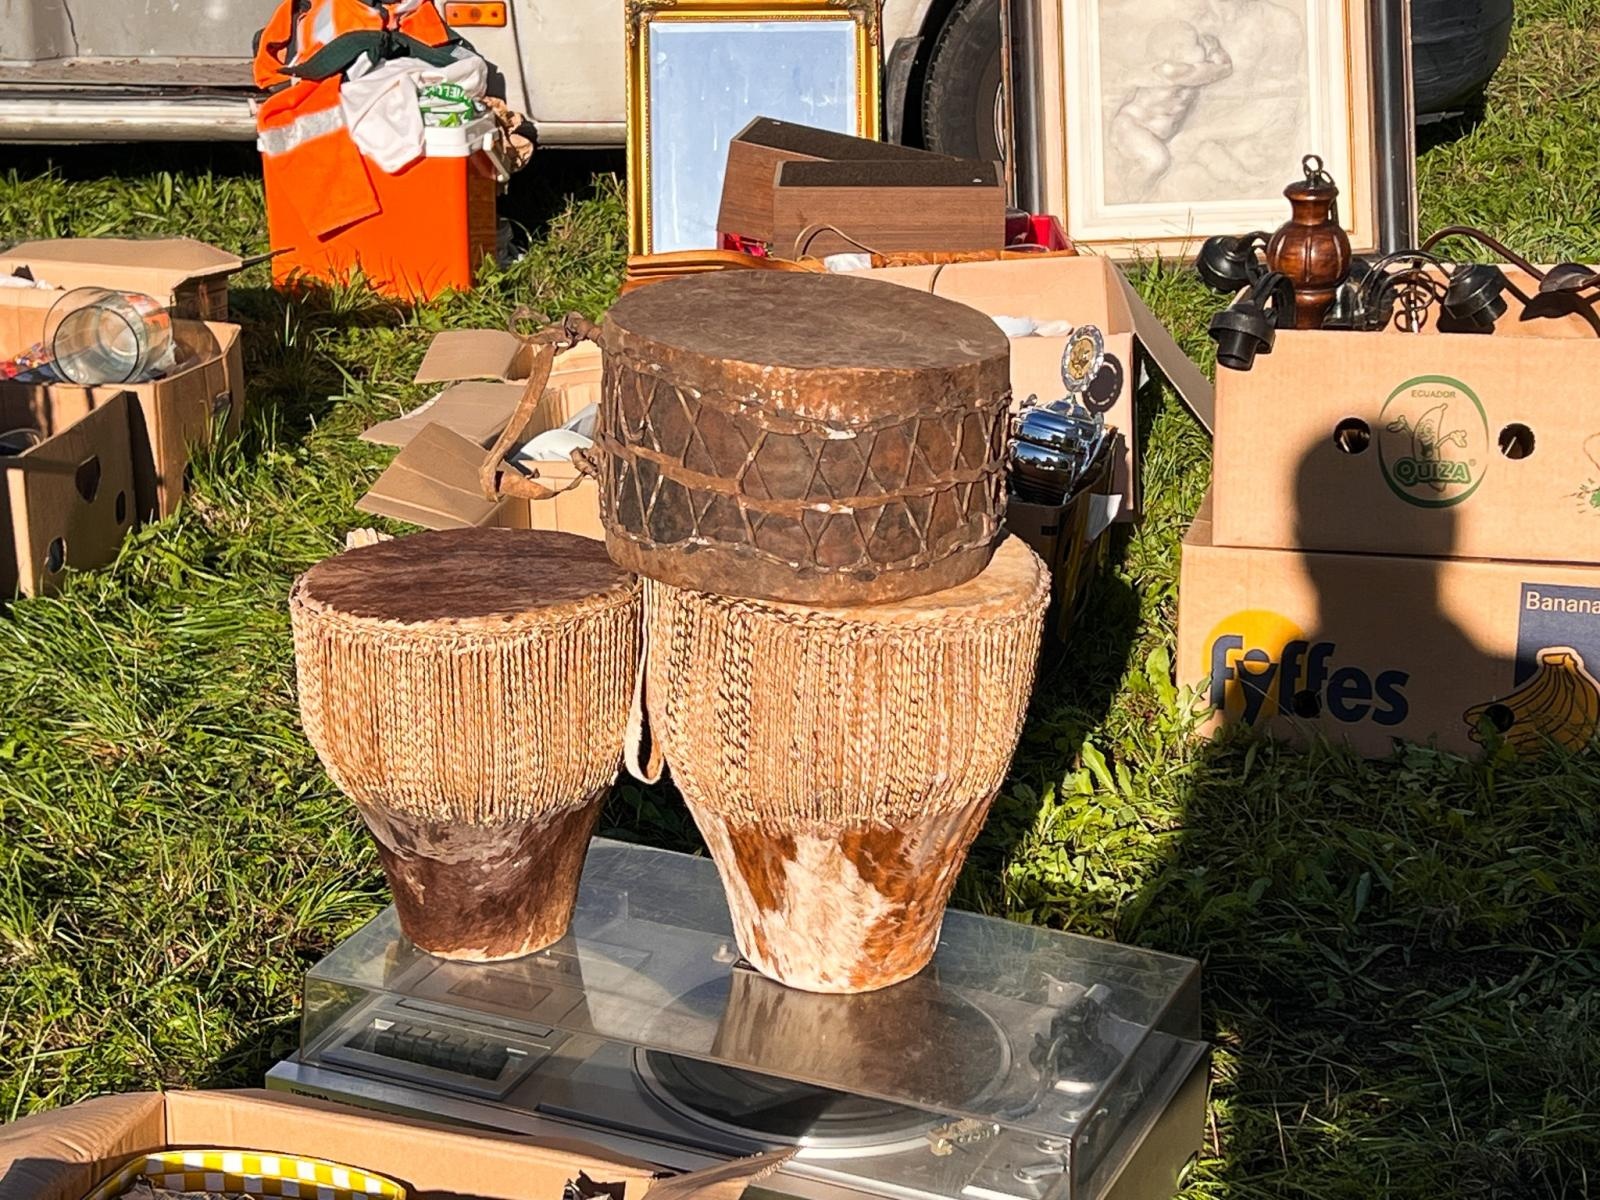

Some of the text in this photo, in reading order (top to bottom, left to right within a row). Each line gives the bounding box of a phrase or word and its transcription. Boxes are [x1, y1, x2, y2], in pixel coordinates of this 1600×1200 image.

[1410, 389, 1457, 399] ECUADOR
[1525, 590, 1600, 615] Banana
[1209, 634, 1410, 727] fyffes
